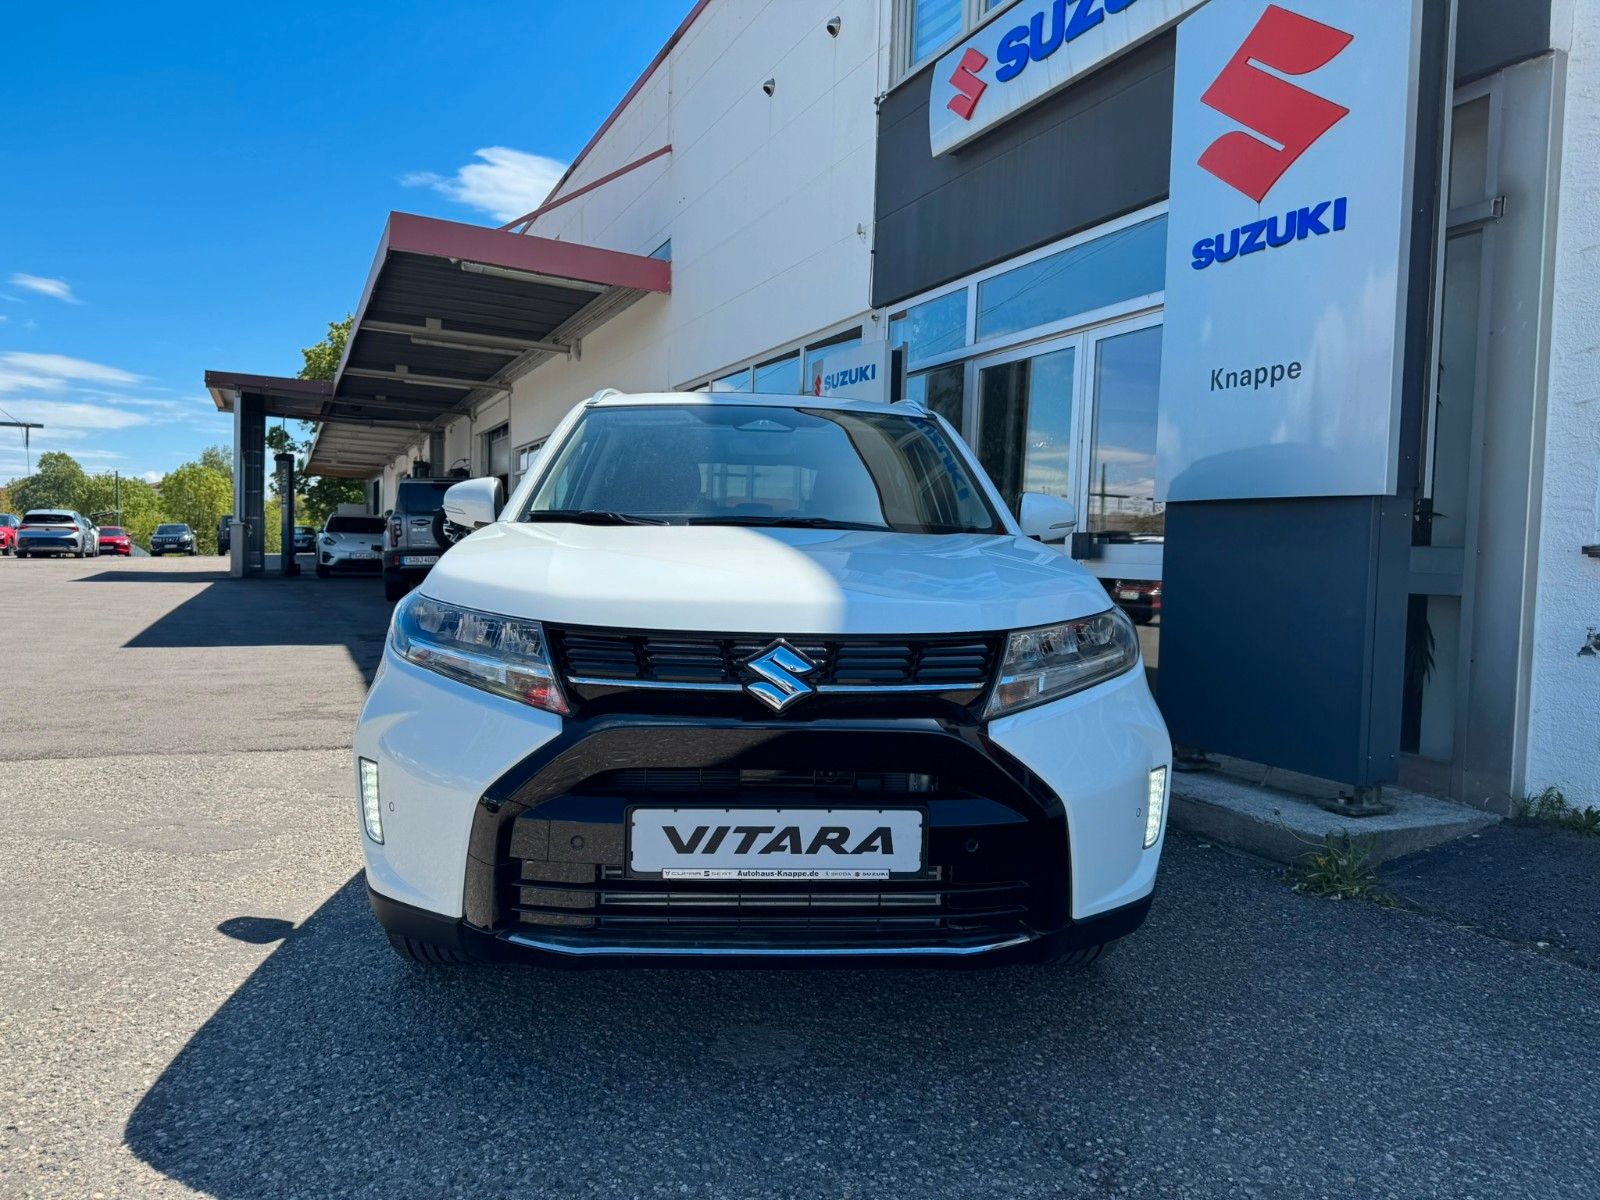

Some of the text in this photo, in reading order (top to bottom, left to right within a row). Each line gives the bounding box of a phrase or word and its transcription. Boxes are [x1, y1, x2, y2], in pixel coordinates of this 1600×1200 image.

[995, 0, 1139, 83] SUZ
[1192, 197, 1348, 270] SUZUKI
[824, 364, 876, 391] SUZUKI
[1211, 361, 1302, 391] Knappe
[662, 826, 894, 854] VITARA
[737, 869, 819, 878] Autohaus-Knappe.de
